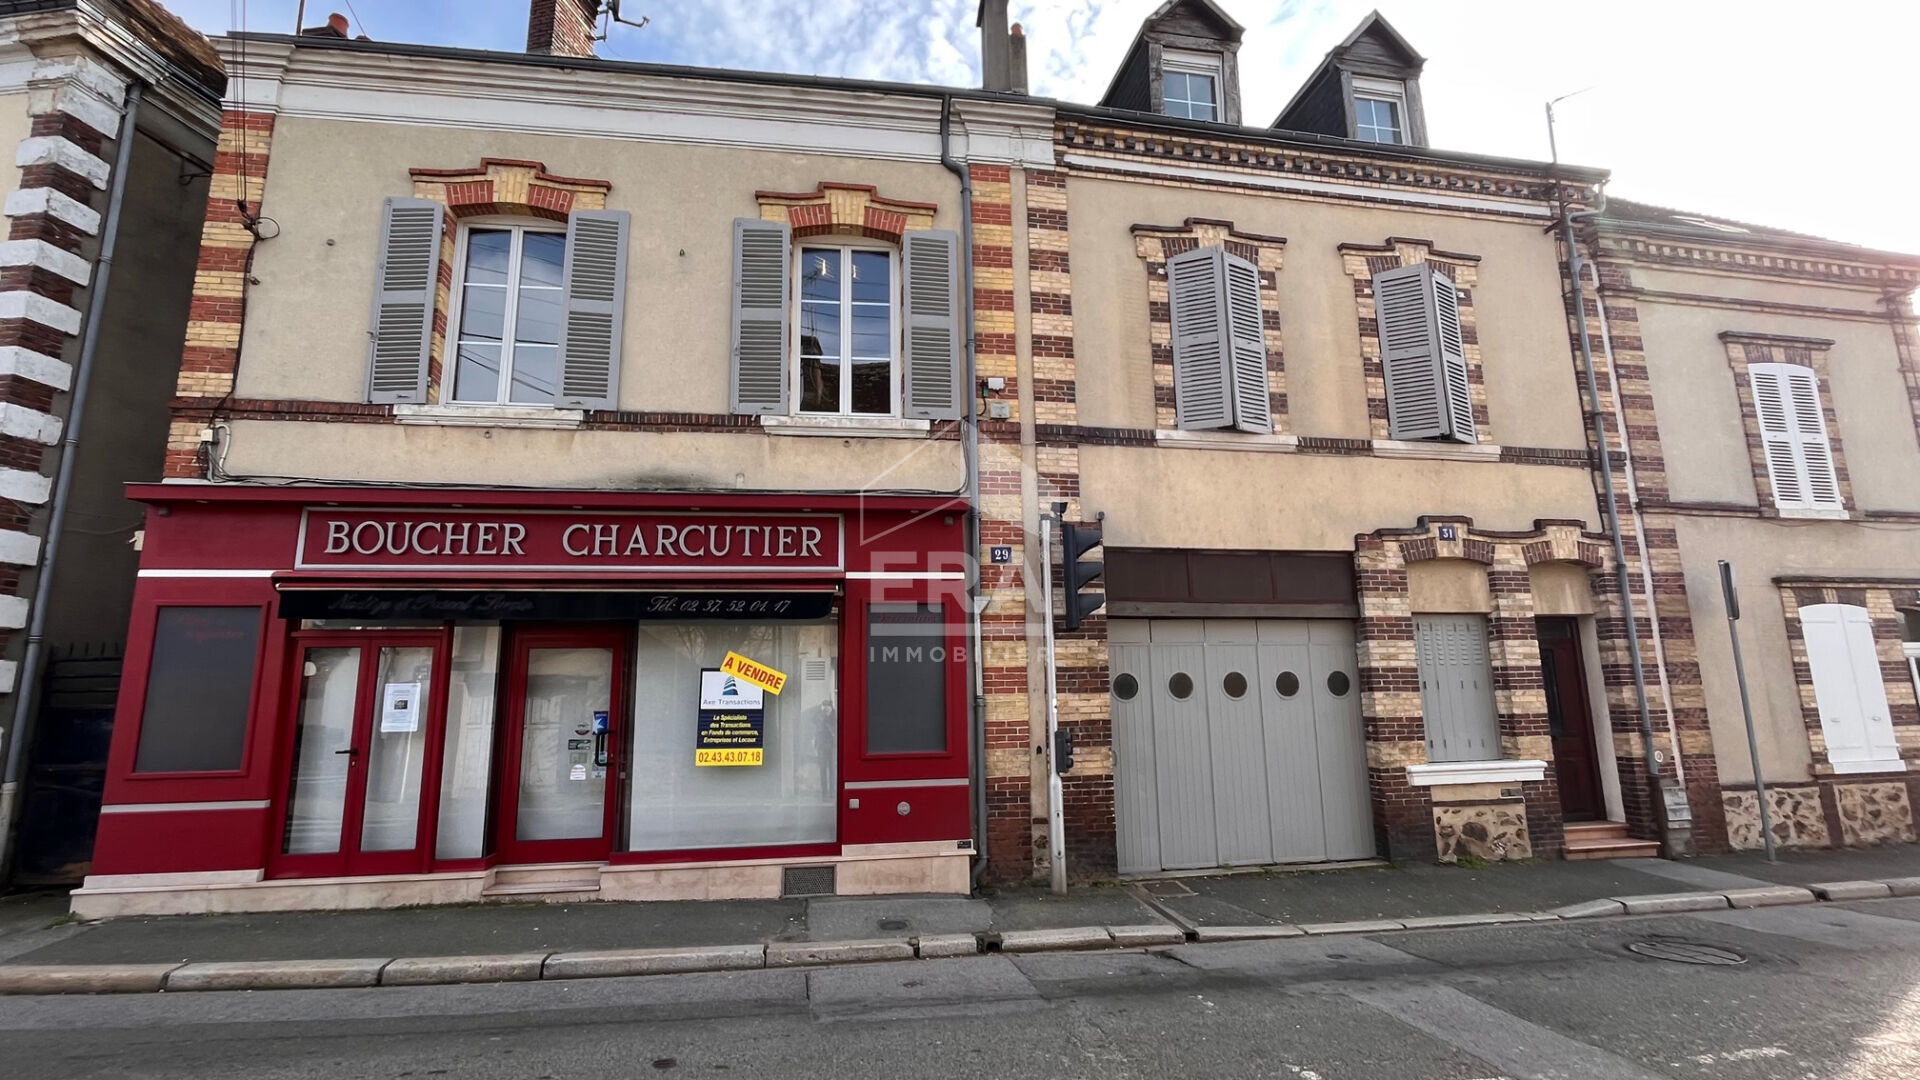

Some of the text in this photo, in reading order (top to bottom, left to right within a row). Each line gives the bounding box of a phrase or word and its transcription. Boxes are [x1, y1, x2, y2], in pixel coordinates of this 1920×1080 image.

[324, 519, 823, 559] BOUCHER CHARCUTIER
[1442, 528, 1453, 539] 31
[994, 549, 1009, 561] 29
[774, 599, 792, 613] 17
[724, 656, 783, 690] A VENDRE
[698, 751, 761, 763] 02.43.43.07.18
